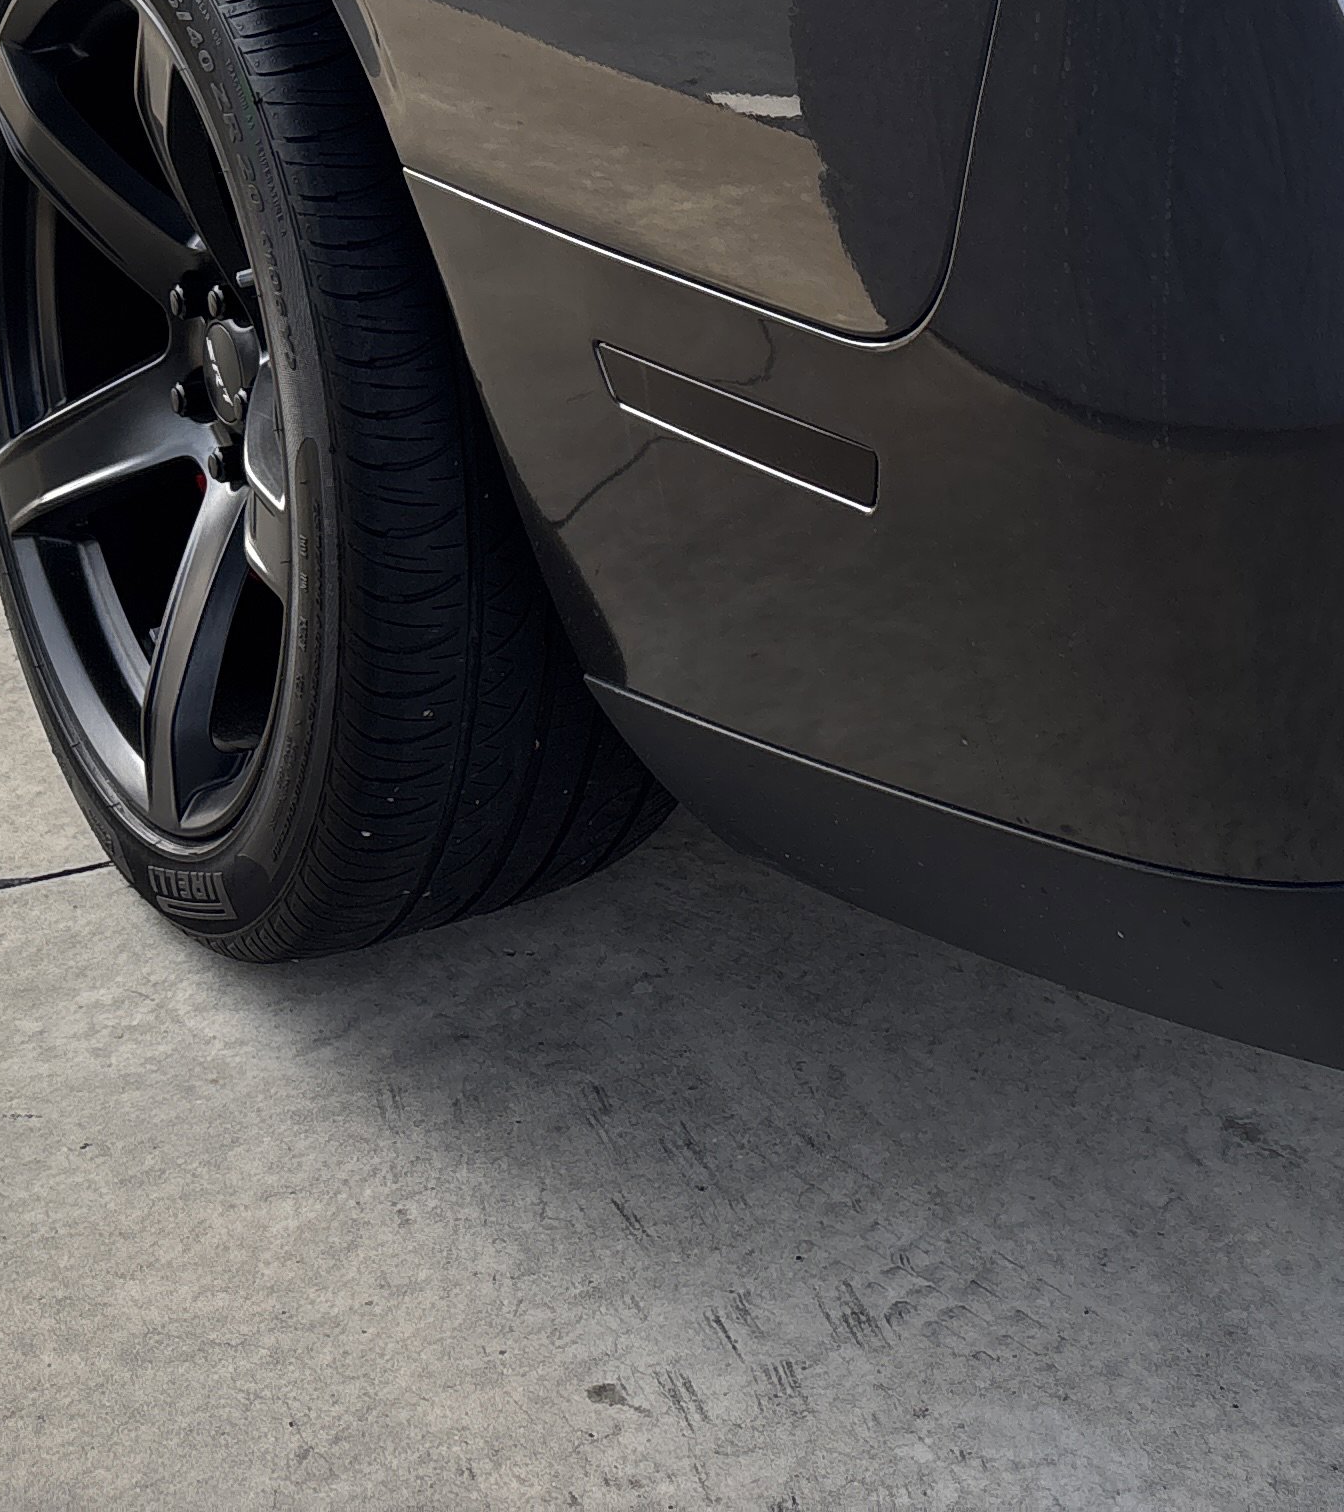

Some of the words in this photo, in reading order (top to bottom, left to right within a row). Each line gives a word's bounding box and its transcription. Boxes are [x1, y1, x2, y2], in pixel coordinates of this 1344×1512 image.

[236, 153, 265, 213] 20
[205, 336, 234, 407] SRT
[147, 864, 239, 921] PIRELLI
